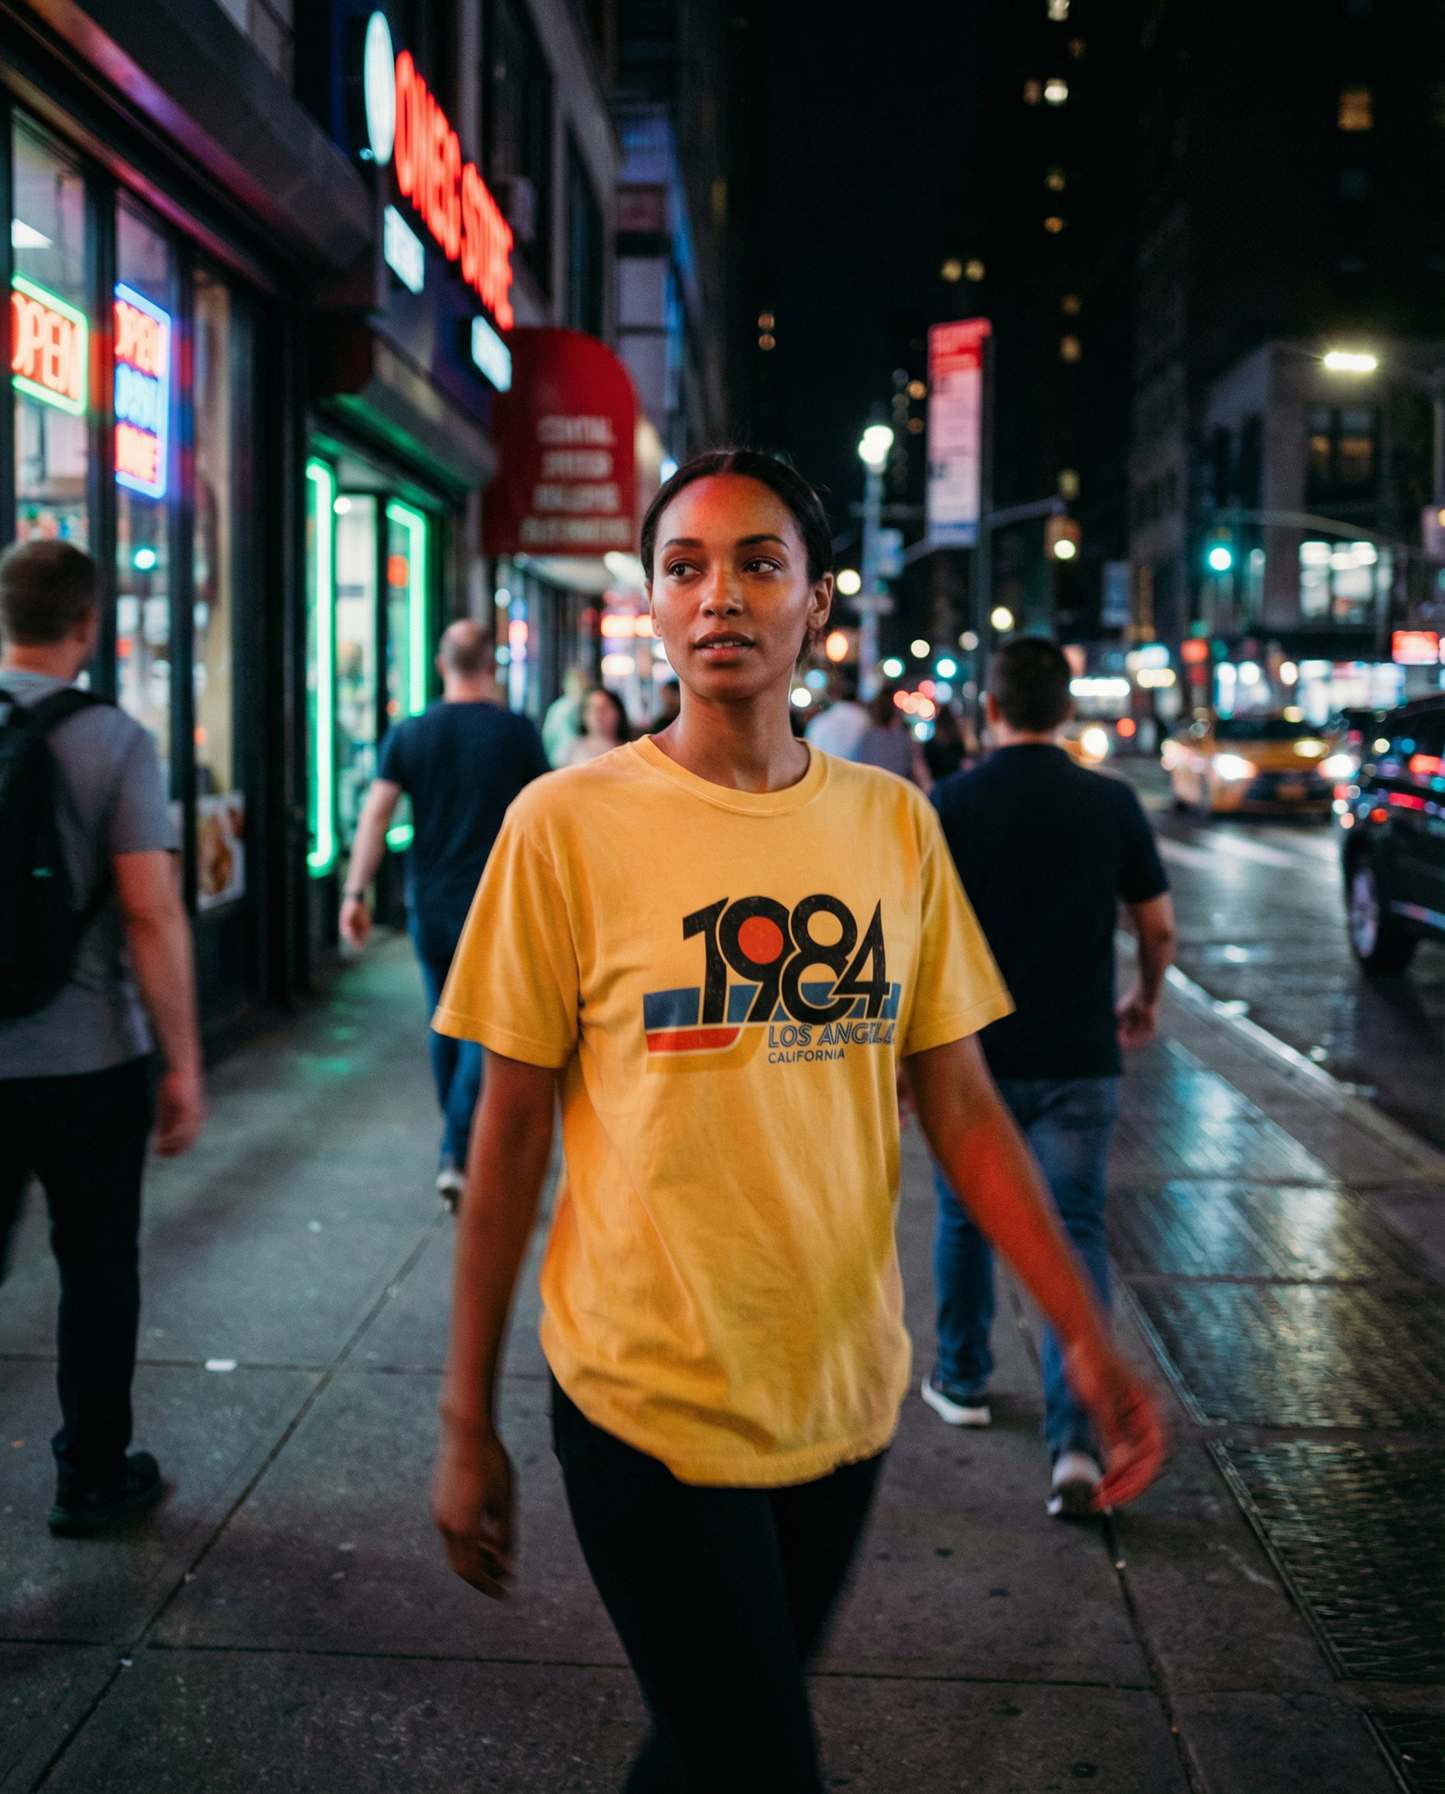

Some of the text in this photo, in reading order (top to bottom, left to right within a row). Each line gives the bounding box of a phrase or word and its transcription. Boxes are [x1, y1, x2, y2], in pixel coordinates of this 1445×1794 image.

[683, 894, 890, 1026] 1984
[768, 1023, 813, 1048] LOS
[768, 1048, 845, 1064] CALIFORNIA
